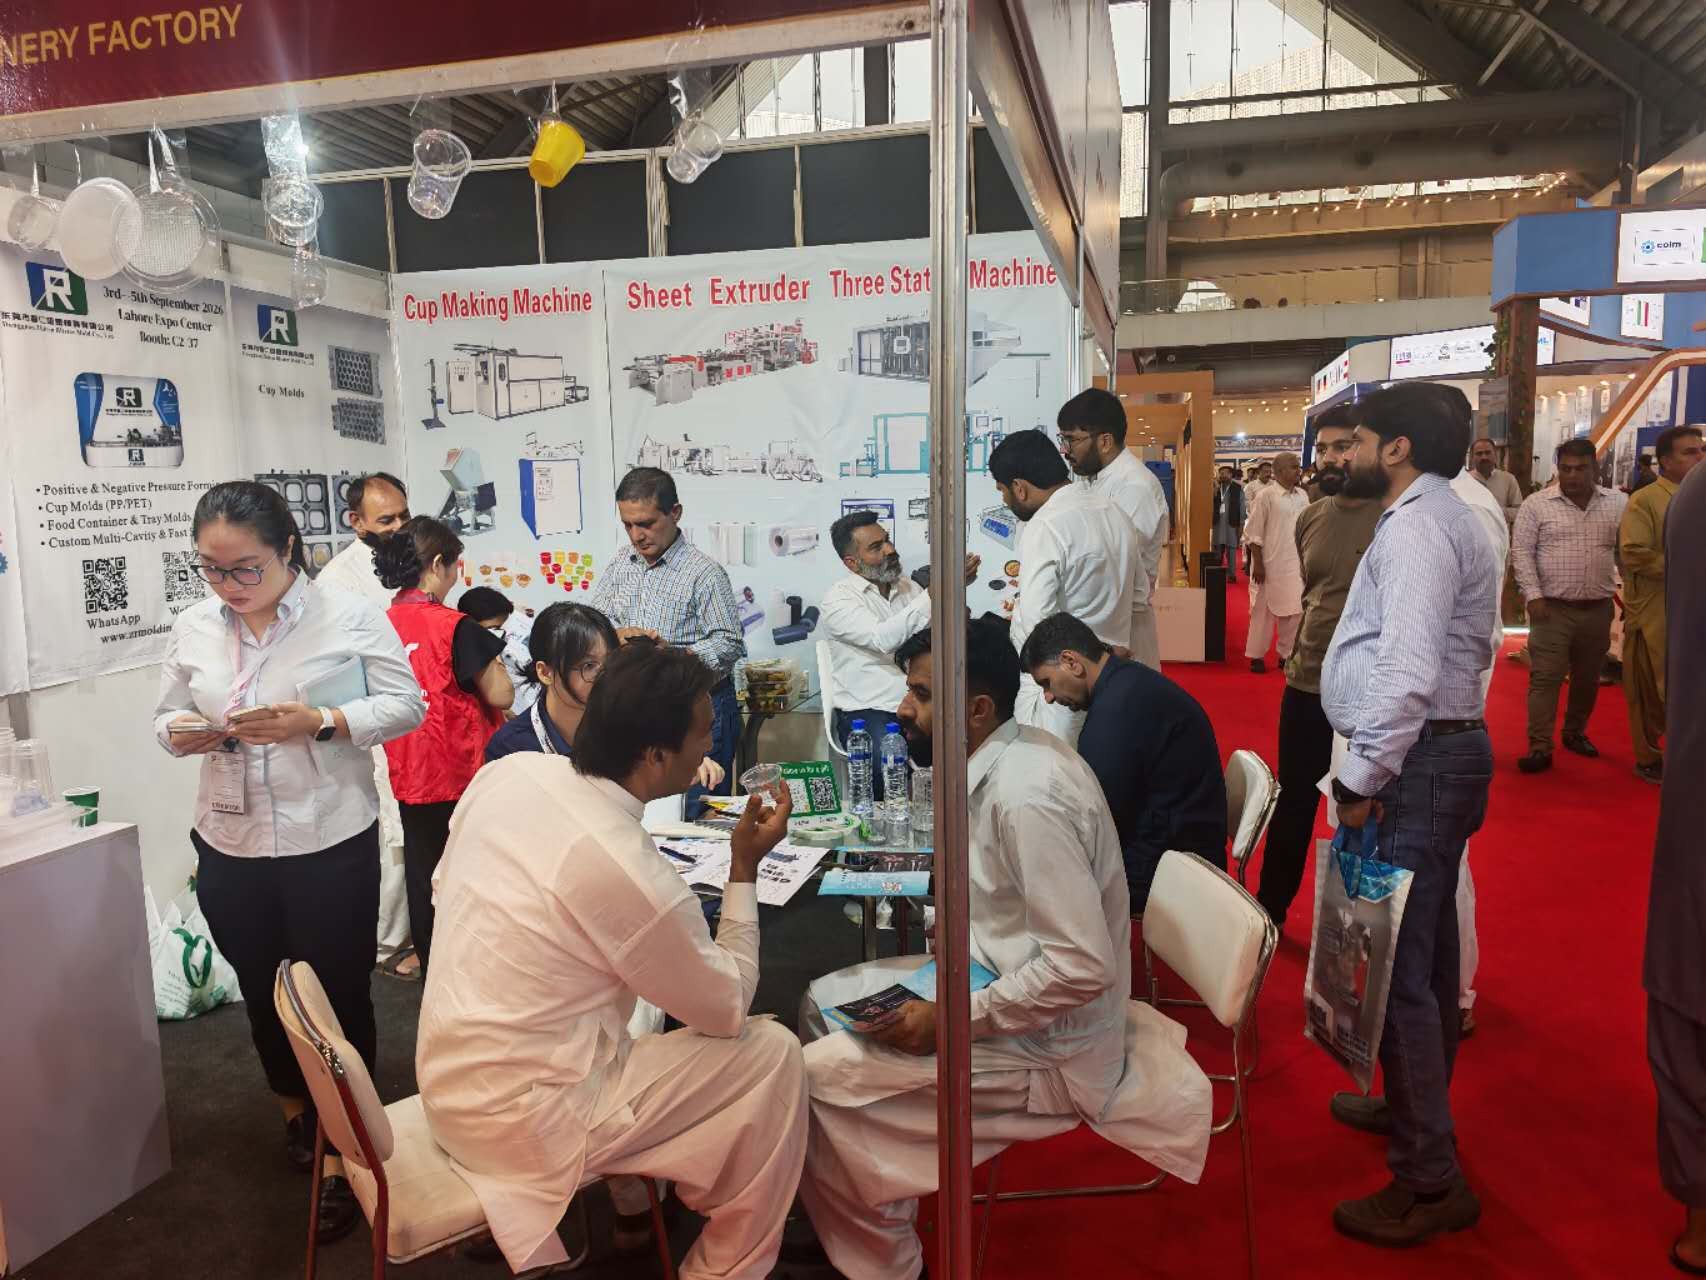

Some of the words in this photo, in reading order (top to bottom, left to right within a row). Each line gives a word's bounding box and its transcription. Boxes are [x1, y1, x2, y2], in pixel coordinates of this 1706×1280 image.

[88, 4, 242, 55] FACTORY
[829, 268, 885, 298] Three
[889, 264, 931, 295] Stat
[968, 256, 1057, 290] Machine
[627, 281, 693, 310] Sheet
[709, 273, 810, 306] Extruder
[149, 293, 200, 312] September
[202, 302, 224, 315] 2026
[403, 293, 438, 325] Cup
[441, 290, 509, 322] Making
[512, 286, 592, 315] Machine
[118, 308, 152, 323] Lahore
[154, 313, 179, 330] Expo
[181, 317, 213, 332] Center
[258, 384, 276, 398] Cup
[279, 386, 305, 399] Molds
[42, 484, 88, 496] Positive
[90, 483, 100, 494] &
[102, 482, 147, 497] Negative
[148, 481, 186, 492] Pressure
[45, 502, 68, 515] Cup
[70, 500, 103, 513] Molds
[105, 498, 153, 512] (PP/PET)
[47, 519, 75, 531] Food
[77, 517, 128, 530] Container
[130, 516, 139, 526] &
[141, 514, 162, 526] Tray
[163, 512, 192, 523] Molds
[48, 536, 91, 549] Custom
[93, 530, 157, 546] Multi-Cavity
[159, 529, 166, 539] &
[168, 528, 188, 539] Fast
[86, 614, 141, 630] WhatsApp
[100, 623, 172, 643] www.zrmoldin
